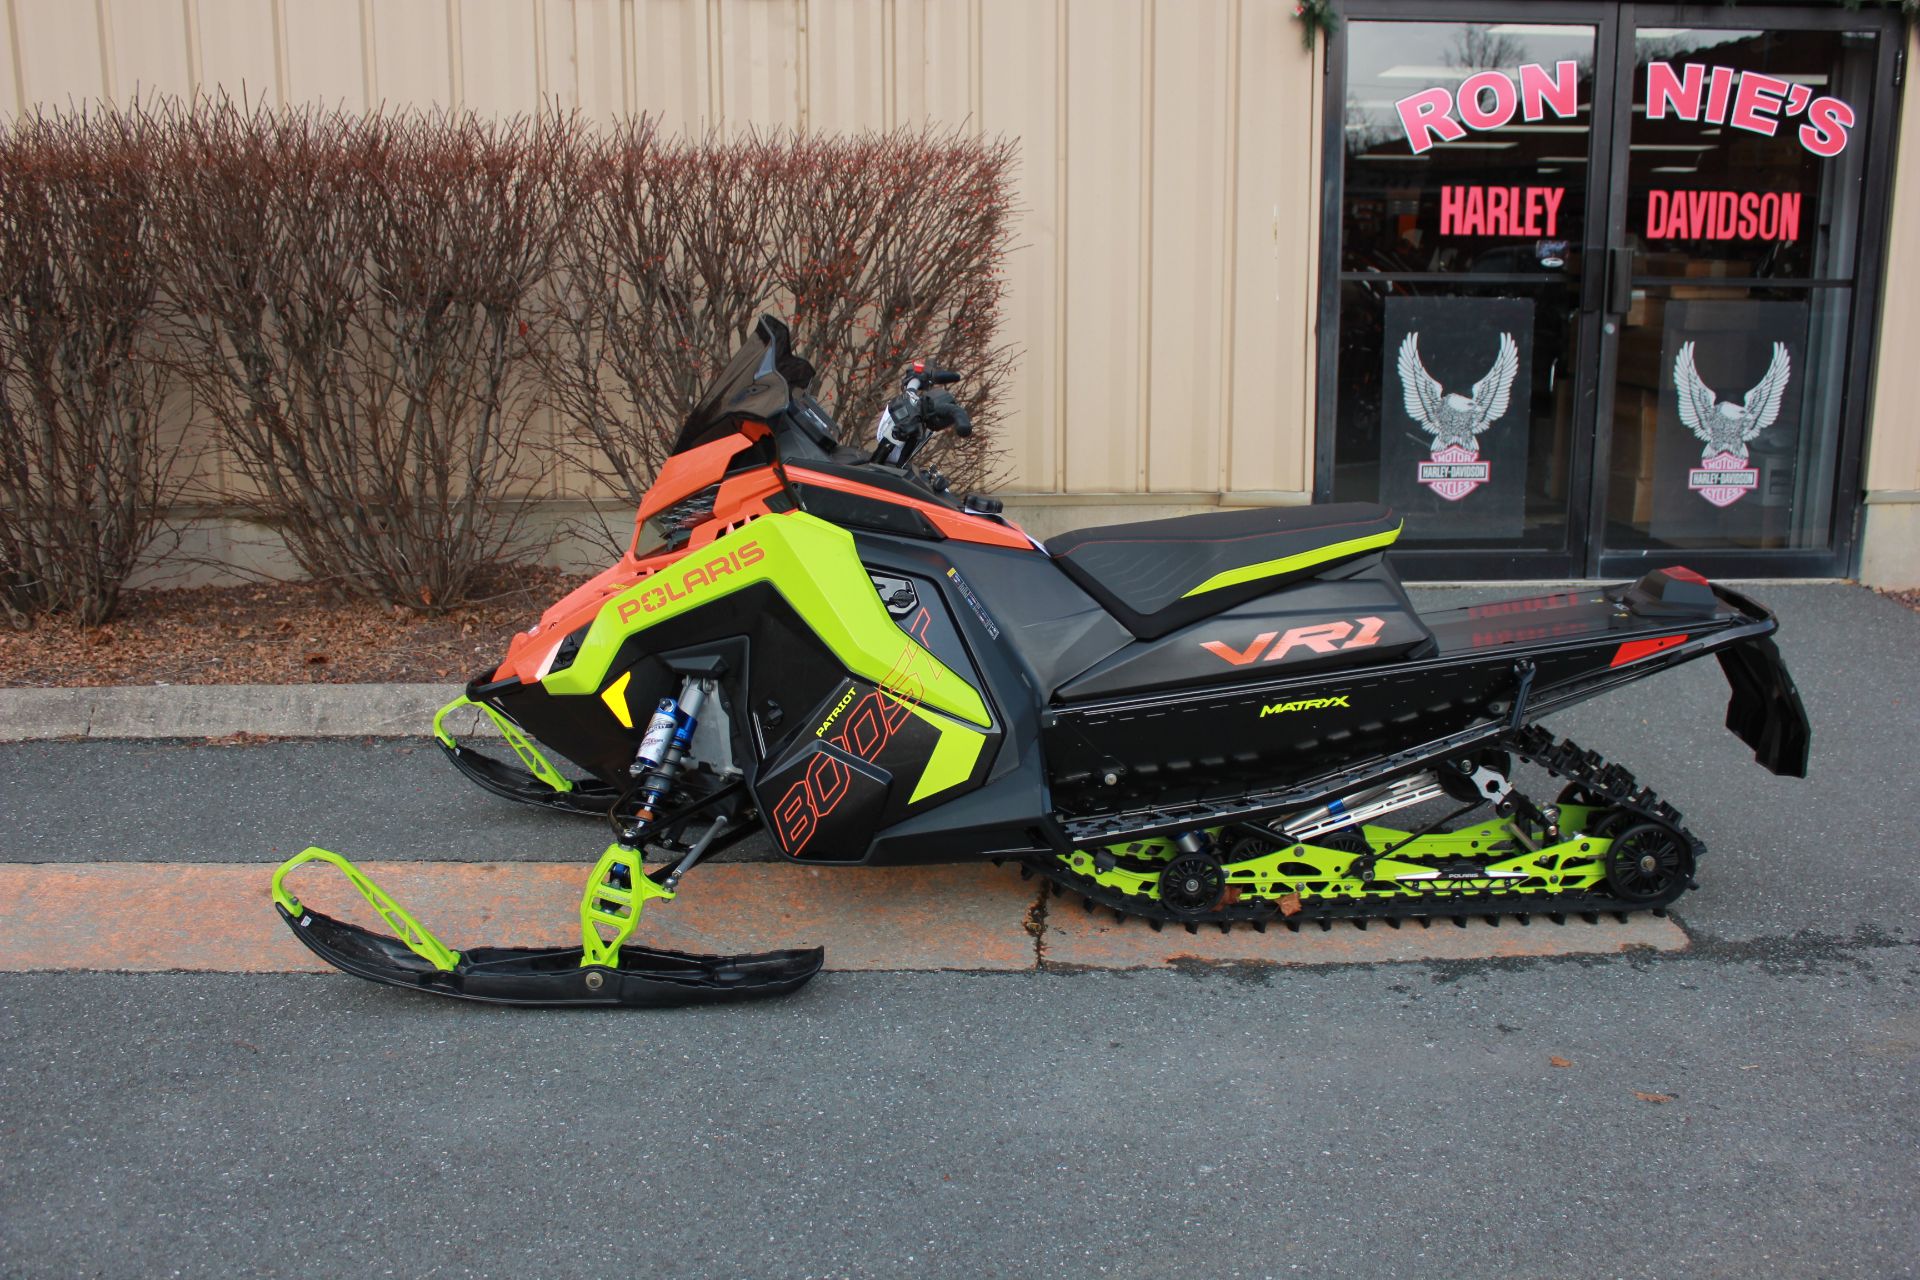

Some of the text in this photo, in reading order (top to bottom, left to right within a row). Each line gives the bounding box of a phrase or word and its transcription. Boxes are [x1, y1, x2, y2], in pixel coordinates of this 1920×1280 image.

[1394, 59, 1856, 158] RON NIE'S
[1440, 185, 1802, 241] HARLEY DAVIDSON
[1437, 453, 1472, 463] MOTOR
[1707, 459, 1741, 470] MOTOR
[1422, 465, 1485, 478] HARLEY-DAVIDSON
[1693, 472, 1753, 485] HARLEY-DAVIDSON
[1435, 481, 1471, 495] CYCLES
[1705, 488, 1739, 500] CYCLES
[617, 540, 766, 625] POLARIS
[1199, 616, 1385, 666] VR1
[815, 686, 858, 738] PATRIOT
[1259, 695, 1352, 718] MATRYX
[773, 606, 944, 857] BOOST
